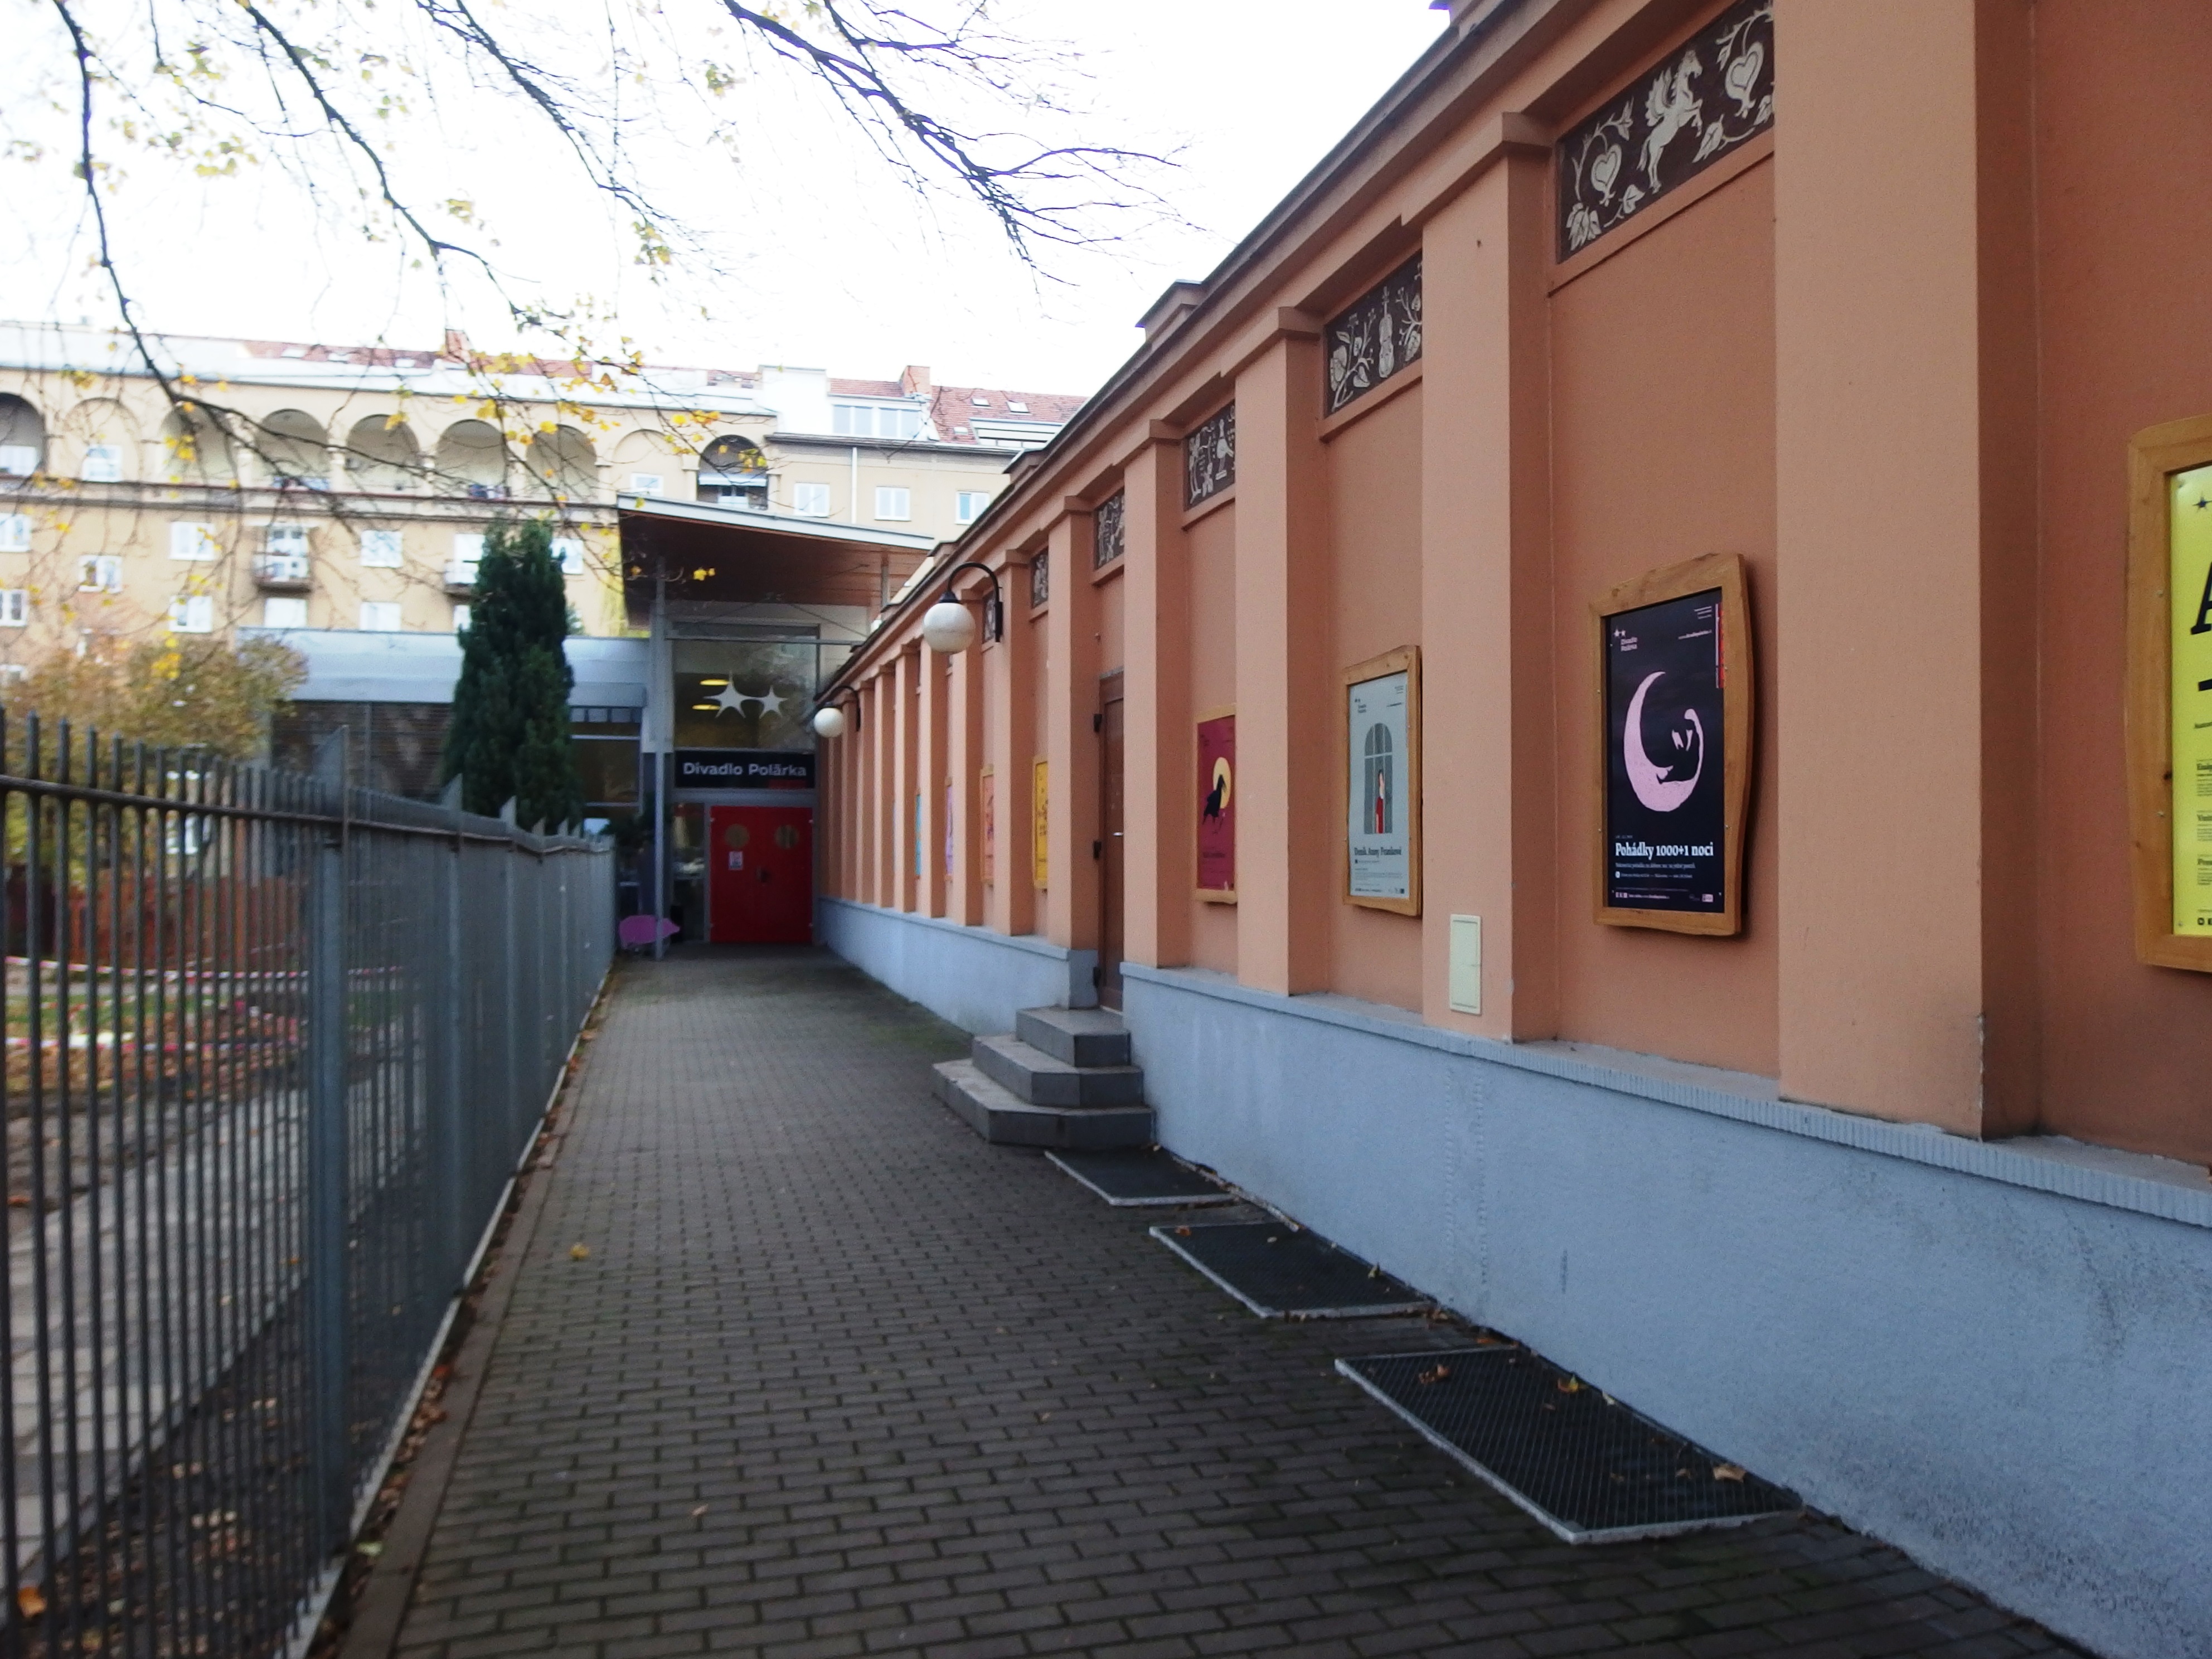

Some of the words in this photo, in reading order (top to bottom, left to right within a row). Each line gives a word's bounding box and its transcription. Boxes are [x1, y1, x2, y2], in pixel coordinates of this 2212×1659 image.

[683, 762, 743, 775] Divadlo
[1615, 841, 1654, 861] Pohádky
[1656, 845, 1689, 856] 1000+1
[1691, 841, 1714, 856] noci
